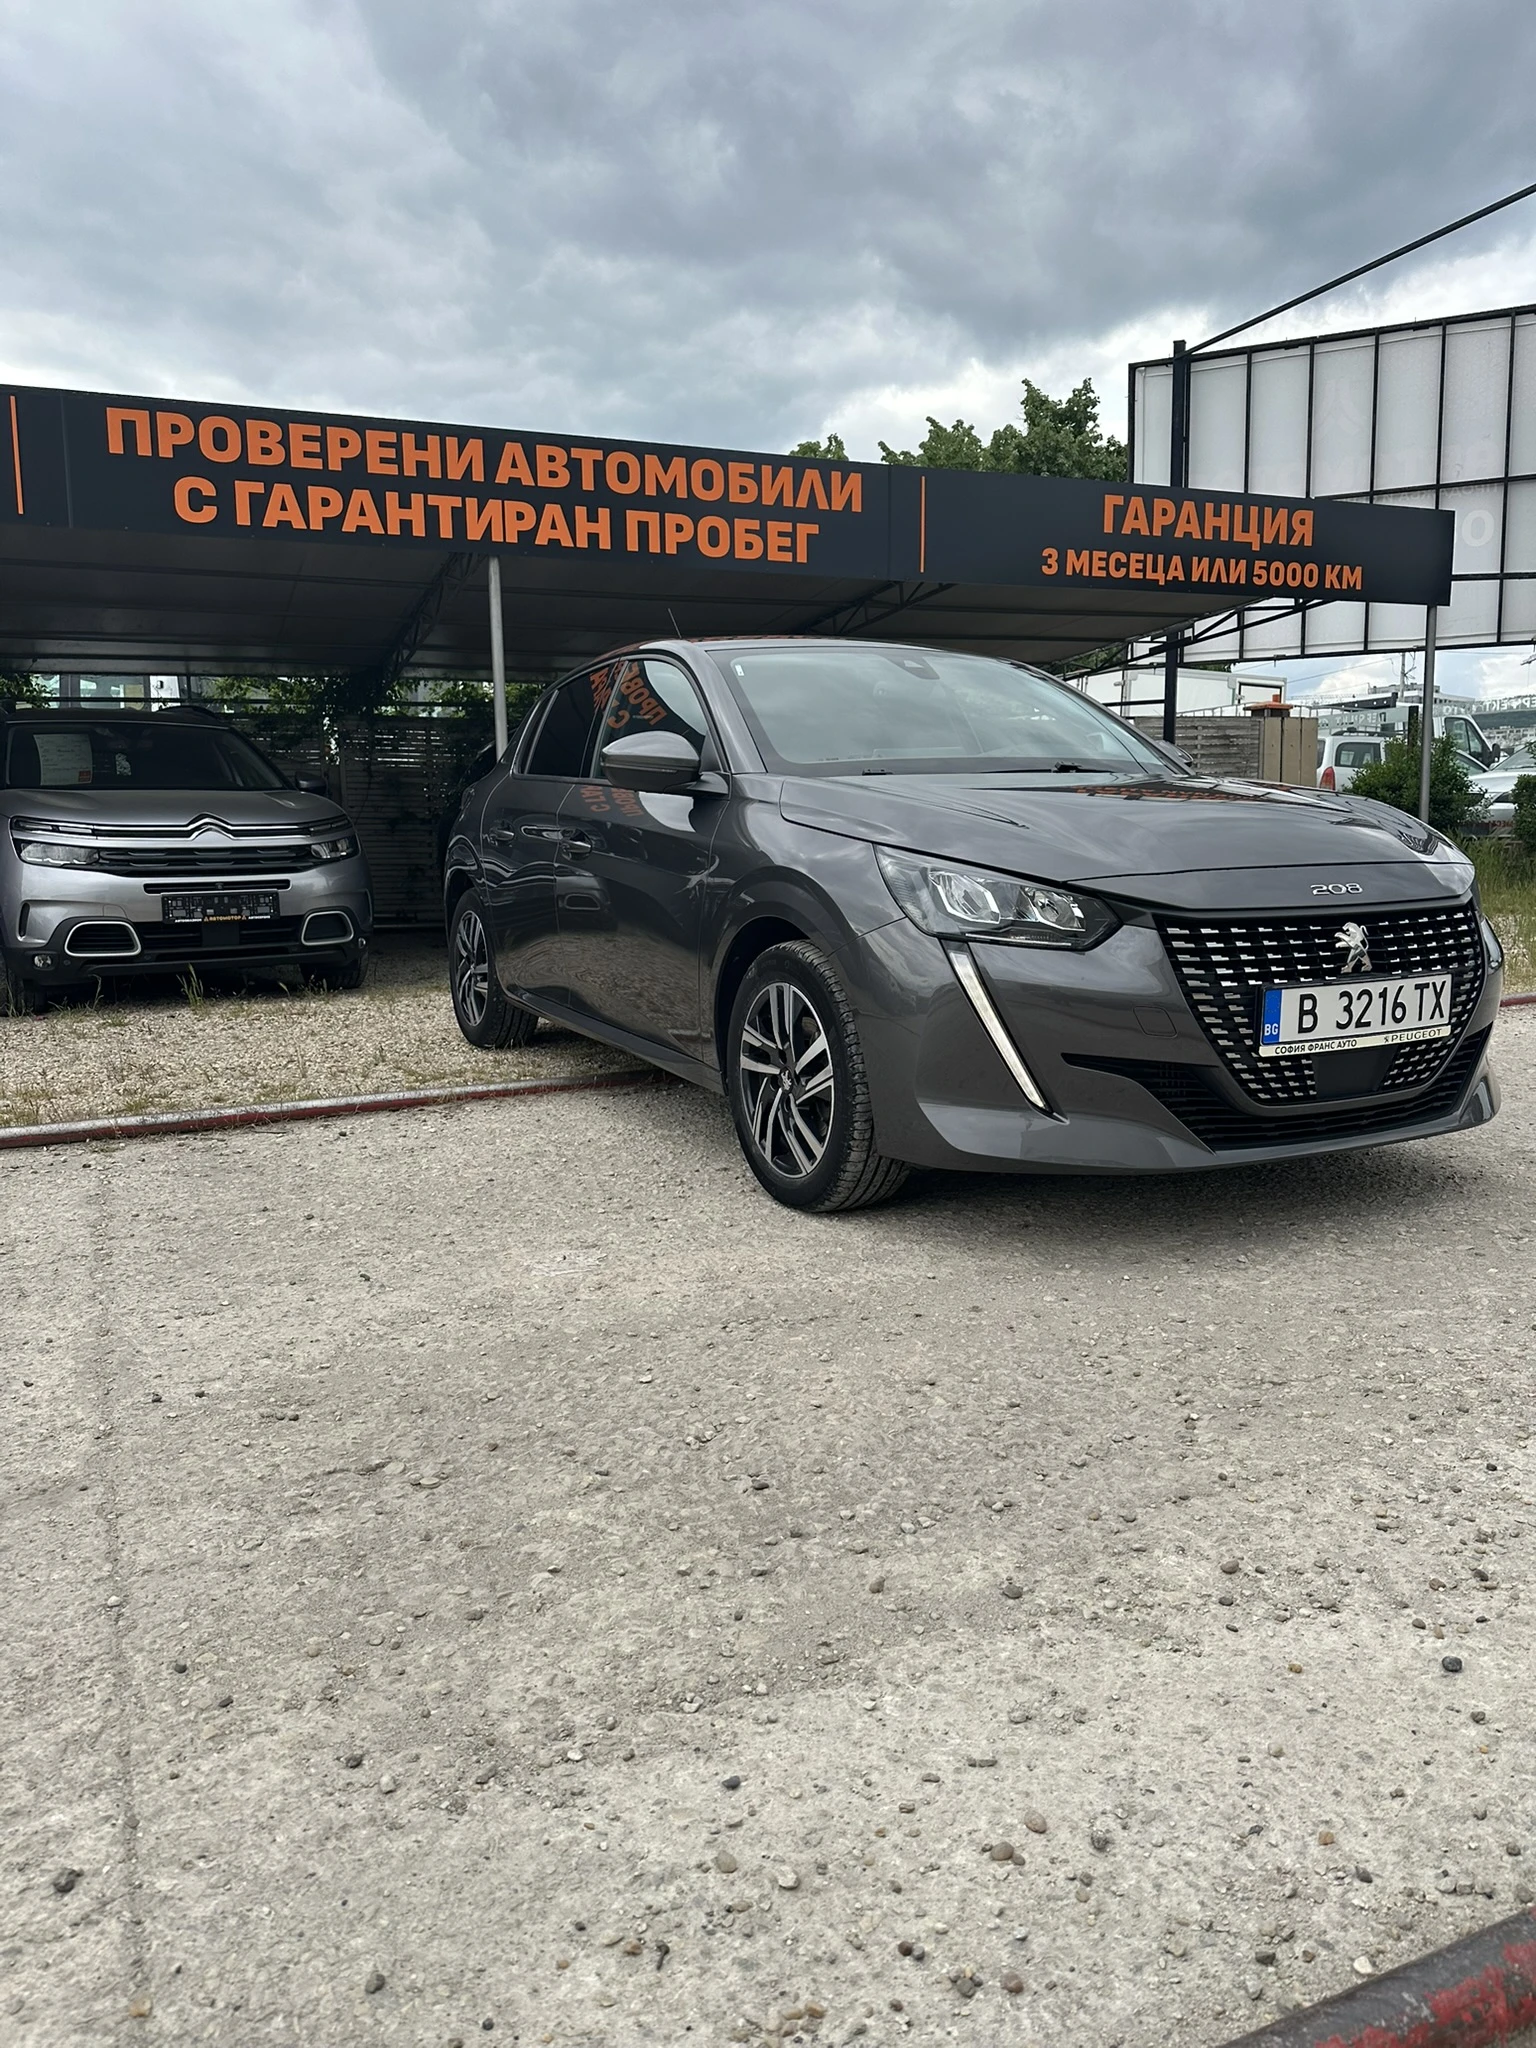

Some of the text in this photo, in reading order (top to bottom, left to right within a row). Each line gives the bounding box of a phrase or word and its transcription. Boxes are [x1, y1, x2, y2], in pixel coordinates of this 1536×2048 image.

[107, 408, 862, 513] ПРОВЕРЕНИ АВТОМОБИЛИ
[174, 476, 819, 563] С ГАРАНТИРАН ПРОБЕГ
[1103, 494, 1314, 551] ГАРАНЦИЯ
[1041, 547, 1363, 591] 3 МЕСЕЦА ИЛИ 5000 КМ
[1310, 882, 1364, 896] 208
[1264, 1023, 1279, 1036] BG
[1335, 985, 1407, 1030] 3216
[1274, 1039, 1358, 1055] СОФИЯ ФРАНС АУТО
[1390, 1028, 1443, 1043] PEUGEOT
